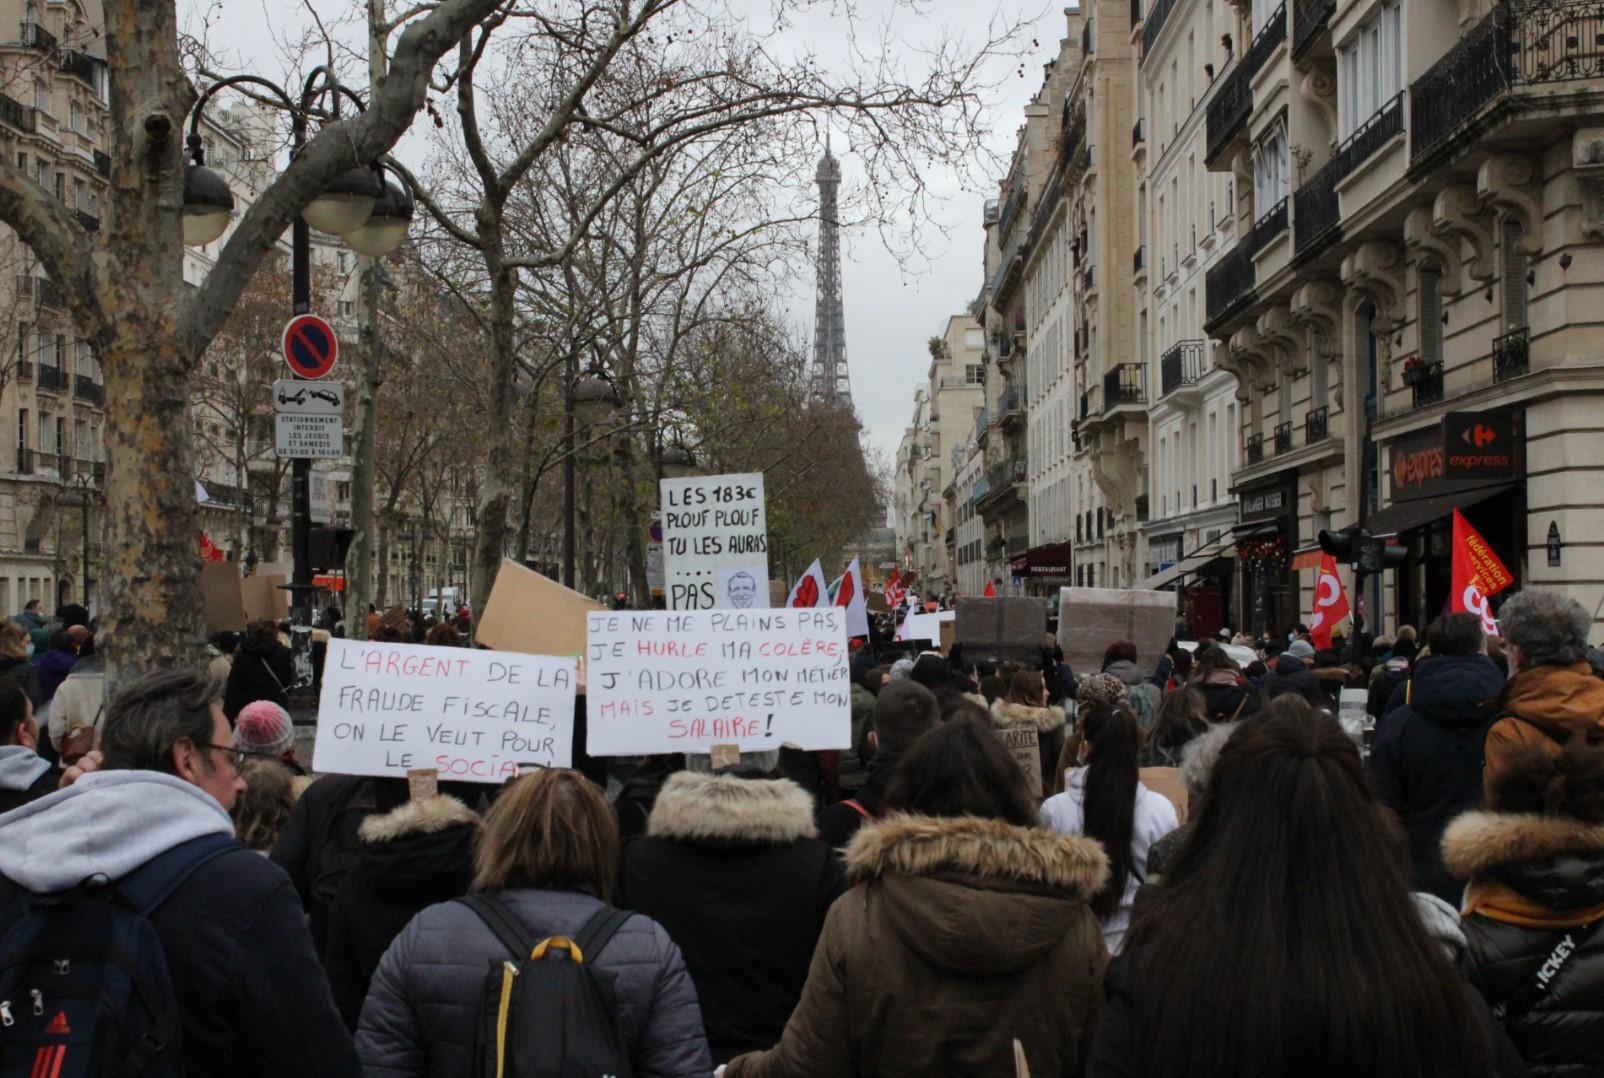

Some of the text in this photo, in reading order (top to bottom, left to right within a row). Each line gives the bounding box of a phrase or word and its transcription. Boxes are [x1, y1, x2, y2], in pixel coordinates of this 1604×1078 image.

[299, 440, 330, 448] SAMEDIS
[1407, 446, 1443, 488] expres
[1449, 455, 1510, 469] express
[669, 485, 757, 507] LES 183€
[666, 508, 760, 530] PLOUF PLOUF
[668, 534, 767, 556] TU LES AURAS
[1466, 535, 1507, 585] fédération
[671, 582, 715, 611] PAS
[589, 616, 618, 633] JE
[632, 616, 654, 632] NE
[667, 616, 694, 632] ME
[798, 612, 839, 633] PAS,
[590, 642, 626, 660] JE
[637, 640, 708, 656] HURLE
[722, 642, 751, 659] MA
[340, 648, 569, 690] L'ARGENT DE LA
[601, 668, 727, 691] J'ADORE
[742, 668, 788, 684] MON
[338, 685, 424, 714] FRAUDE
[667, 699, 692, 712] JE
[814, 691, 848, 707] MON
[334, 722, 555, 758] ON LE VEUT POUR
[386, 751, 413, 768] LE
